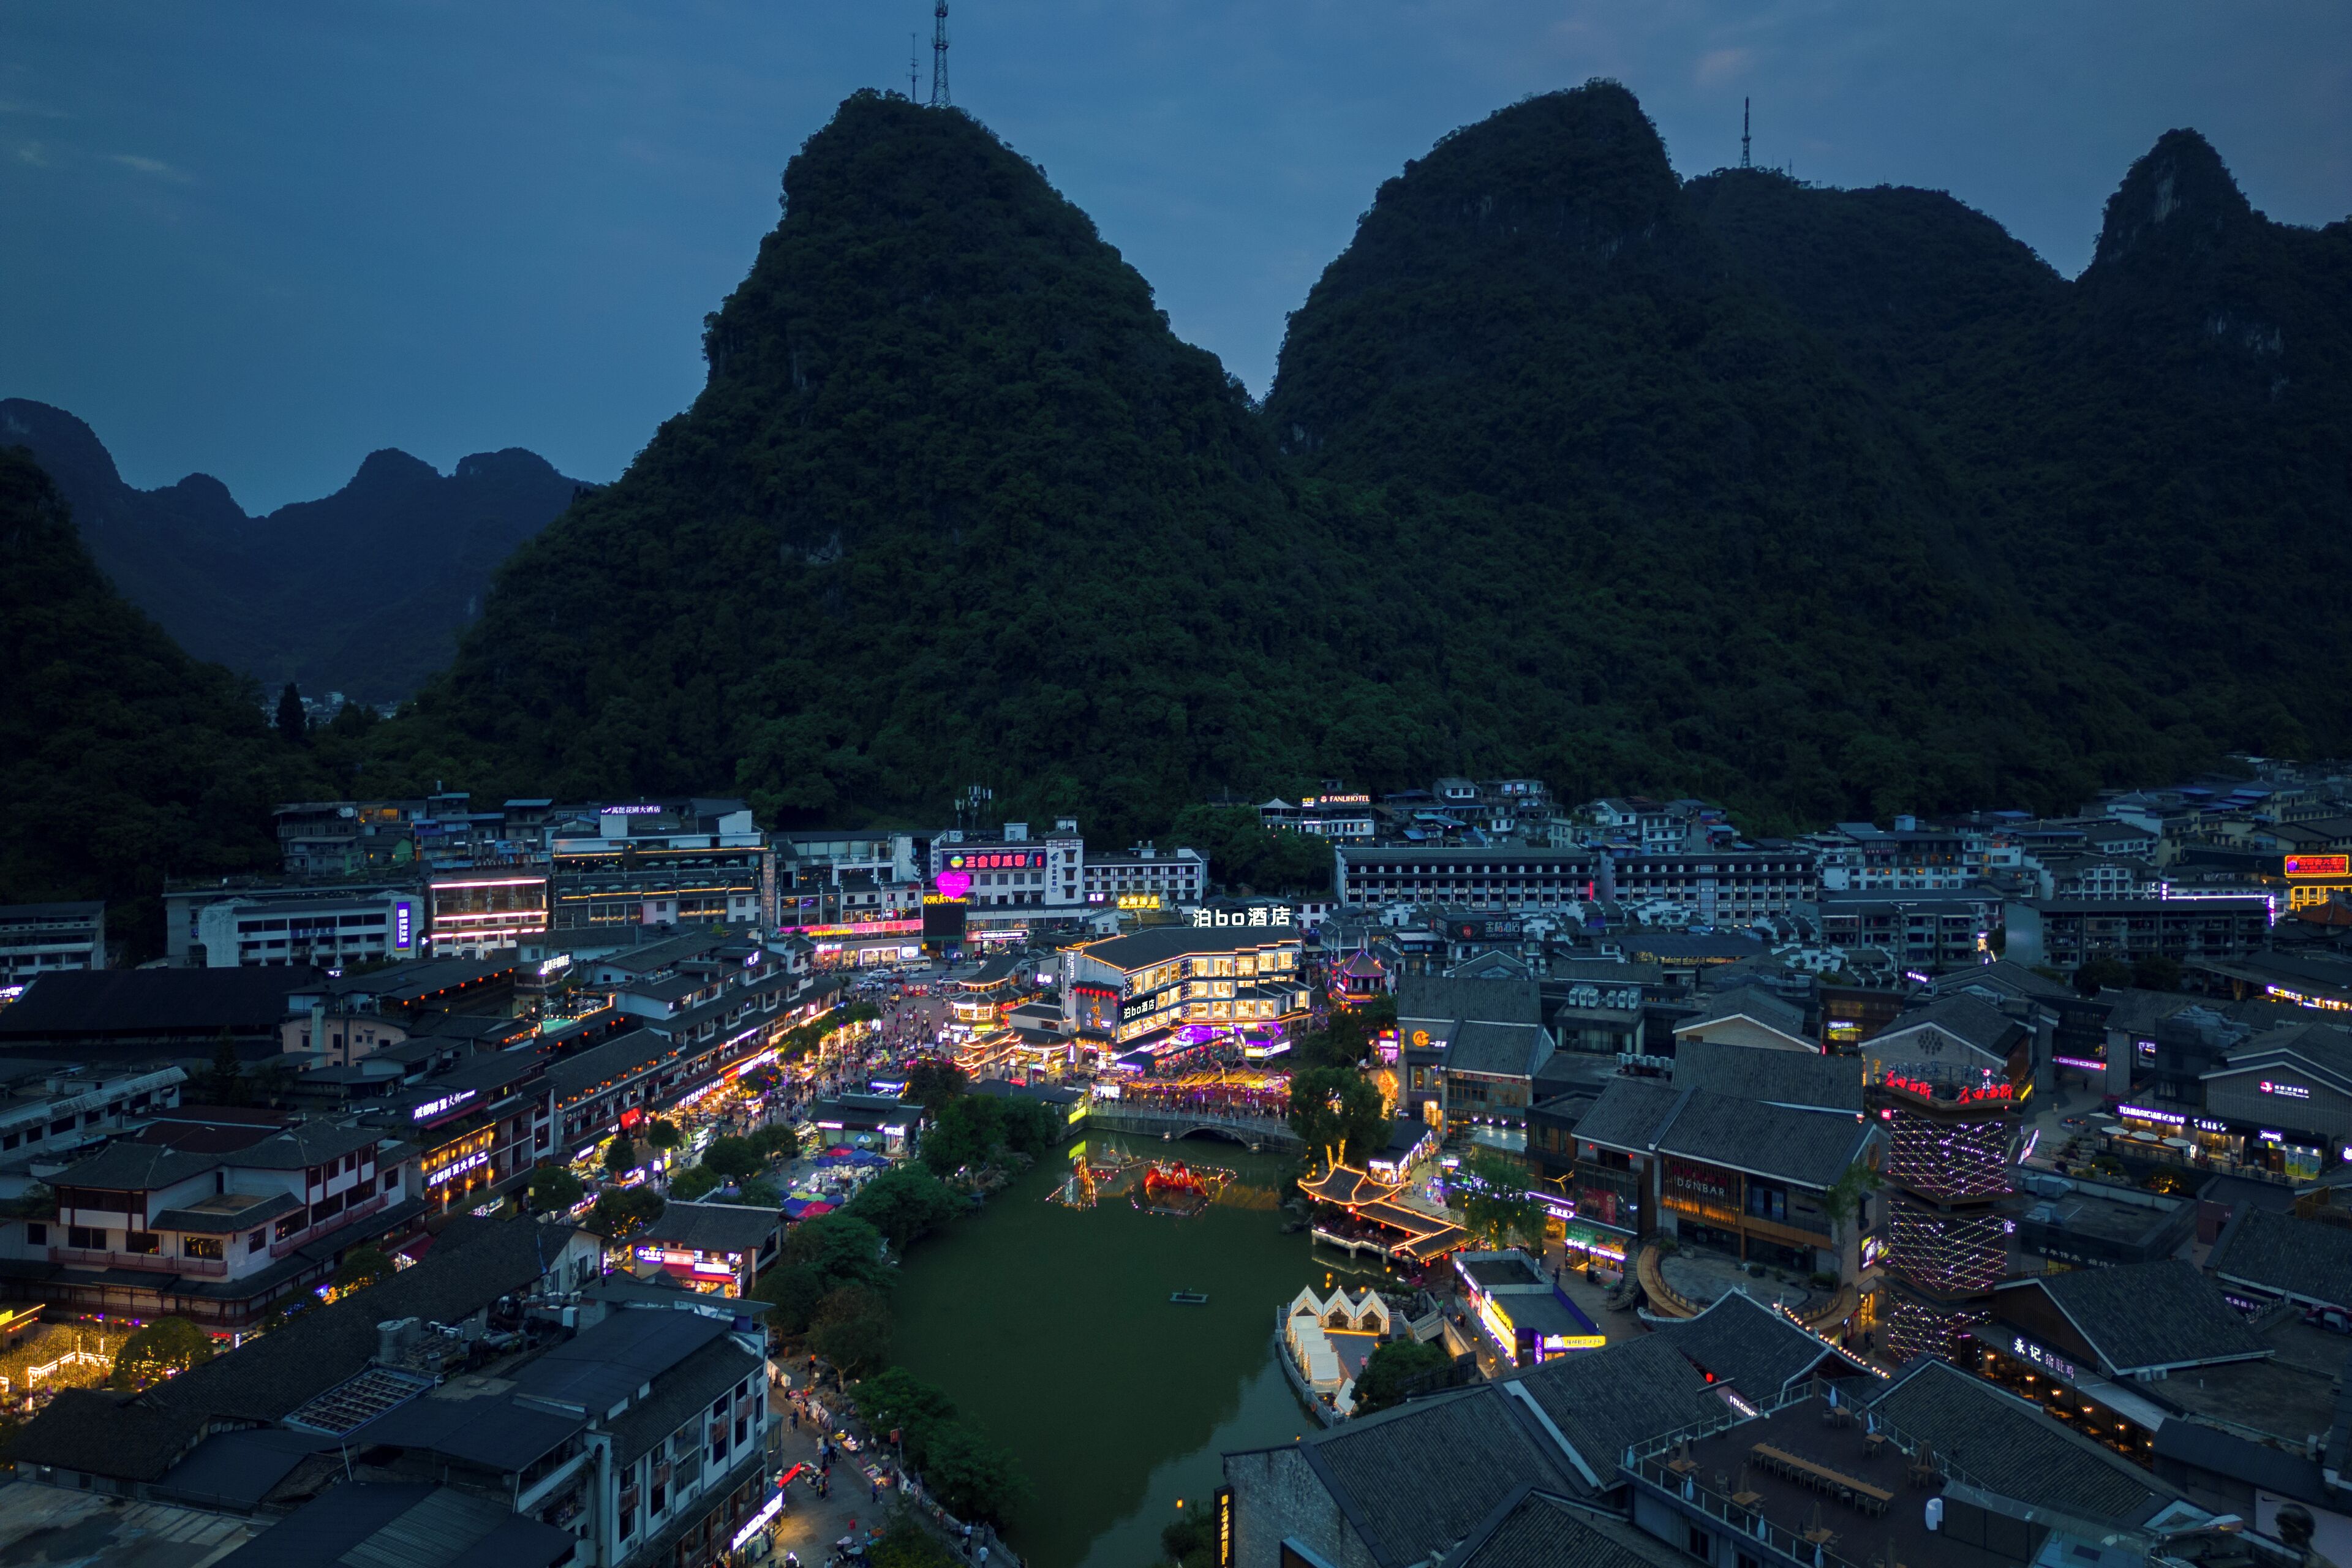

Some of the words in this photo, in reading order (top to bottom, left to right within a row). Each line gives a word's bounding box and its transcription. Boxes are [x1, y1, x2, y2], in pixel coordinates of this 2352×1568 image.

[1193, 907, 1291, 927] 泊bo酒店
[1485, 921, 1520, 932] 金桔酒店
[1123, 999, 1155, 1020] 泊bo酒店
